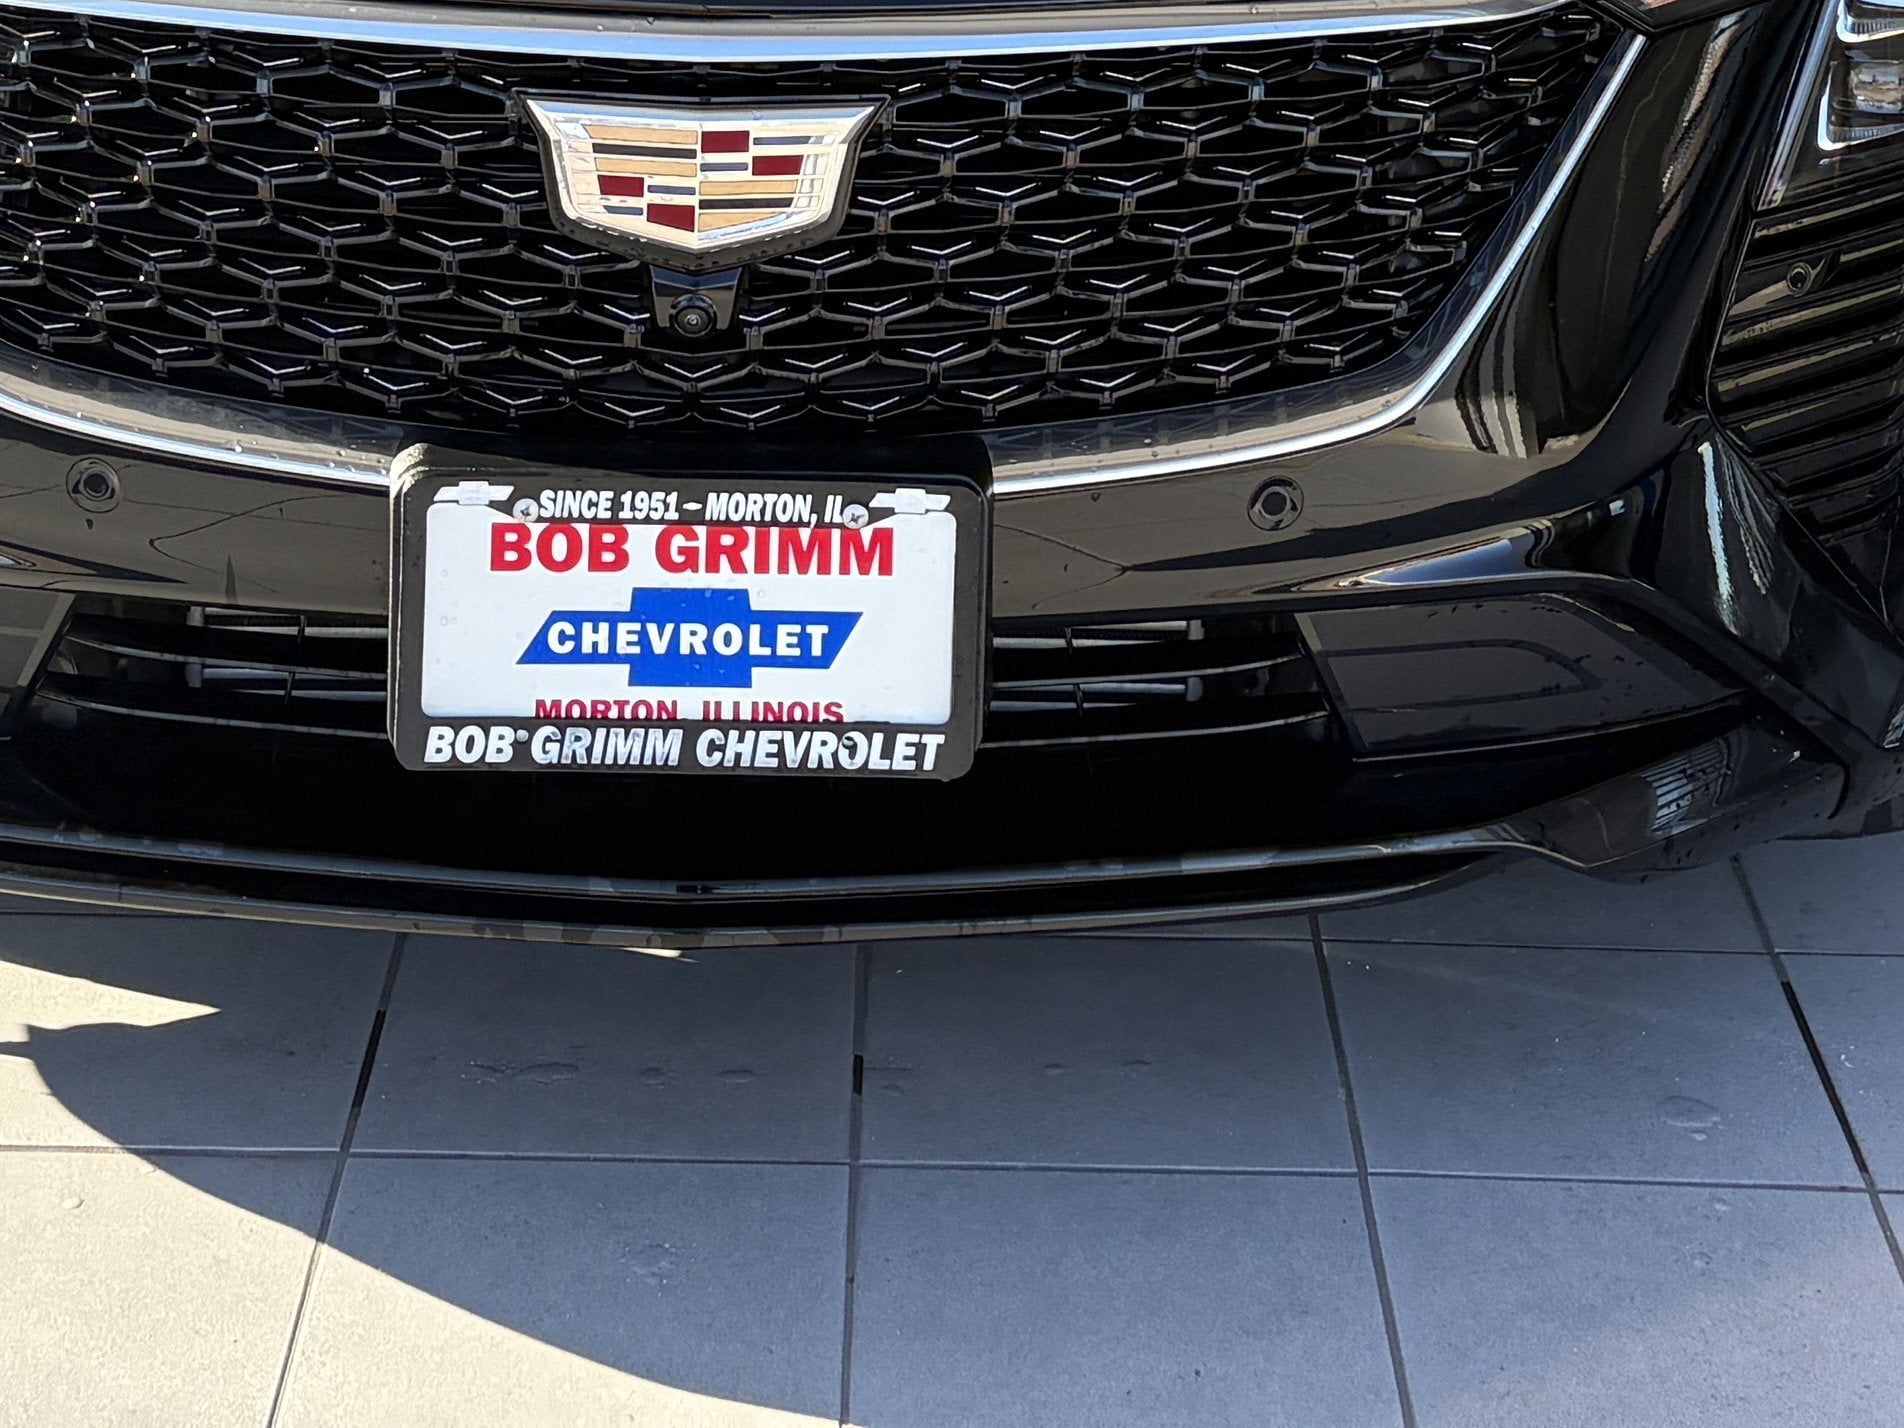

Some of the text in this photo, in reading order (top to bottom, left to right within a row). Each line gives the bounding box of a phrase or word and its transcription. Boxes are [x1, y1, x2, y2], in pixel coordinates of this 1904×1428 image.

[537, 489, 613, 519] SINCE
[617, 491, 679, 521] 1951
[705, 492, 819, 529] MORTON,
[824, 495, 843, 524] IL
[490, 522, 894, 576] BOB GRIMM
[547, 621, 830, 658] CHEVROLET
[534, 698, 845, 724] MORTON ILLINOIS
[423, 725, 945, 772] BOB GRIMM CHEVROLET
